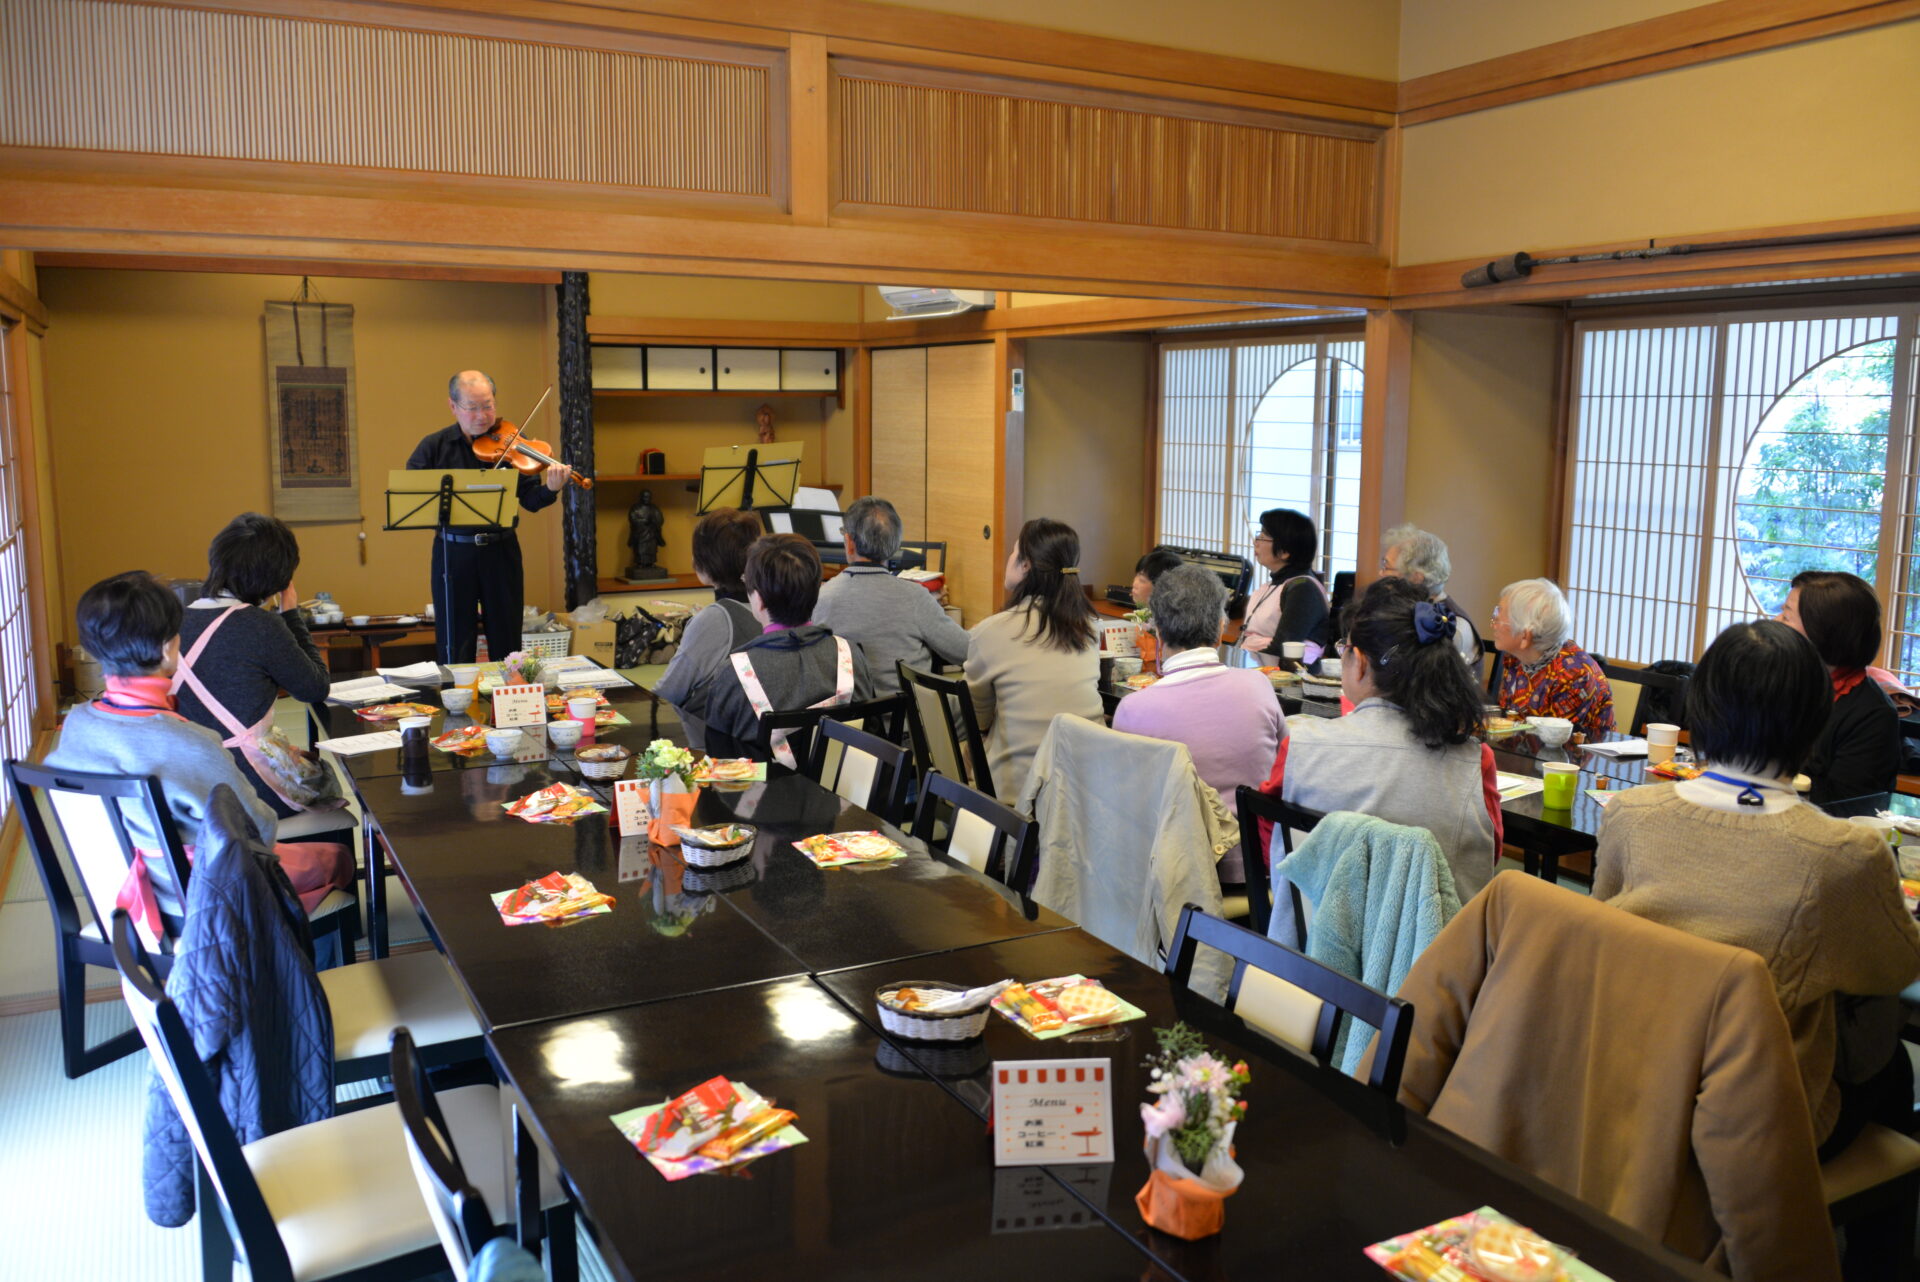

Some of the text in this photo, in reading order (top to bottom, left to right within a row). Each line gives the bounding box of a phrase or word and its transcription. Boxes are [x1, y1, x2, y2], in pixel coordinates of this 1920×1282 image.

[1029, 1098, 1067, 1107] Menu
[1018, 1130, 1057, 1138] コーヒー
